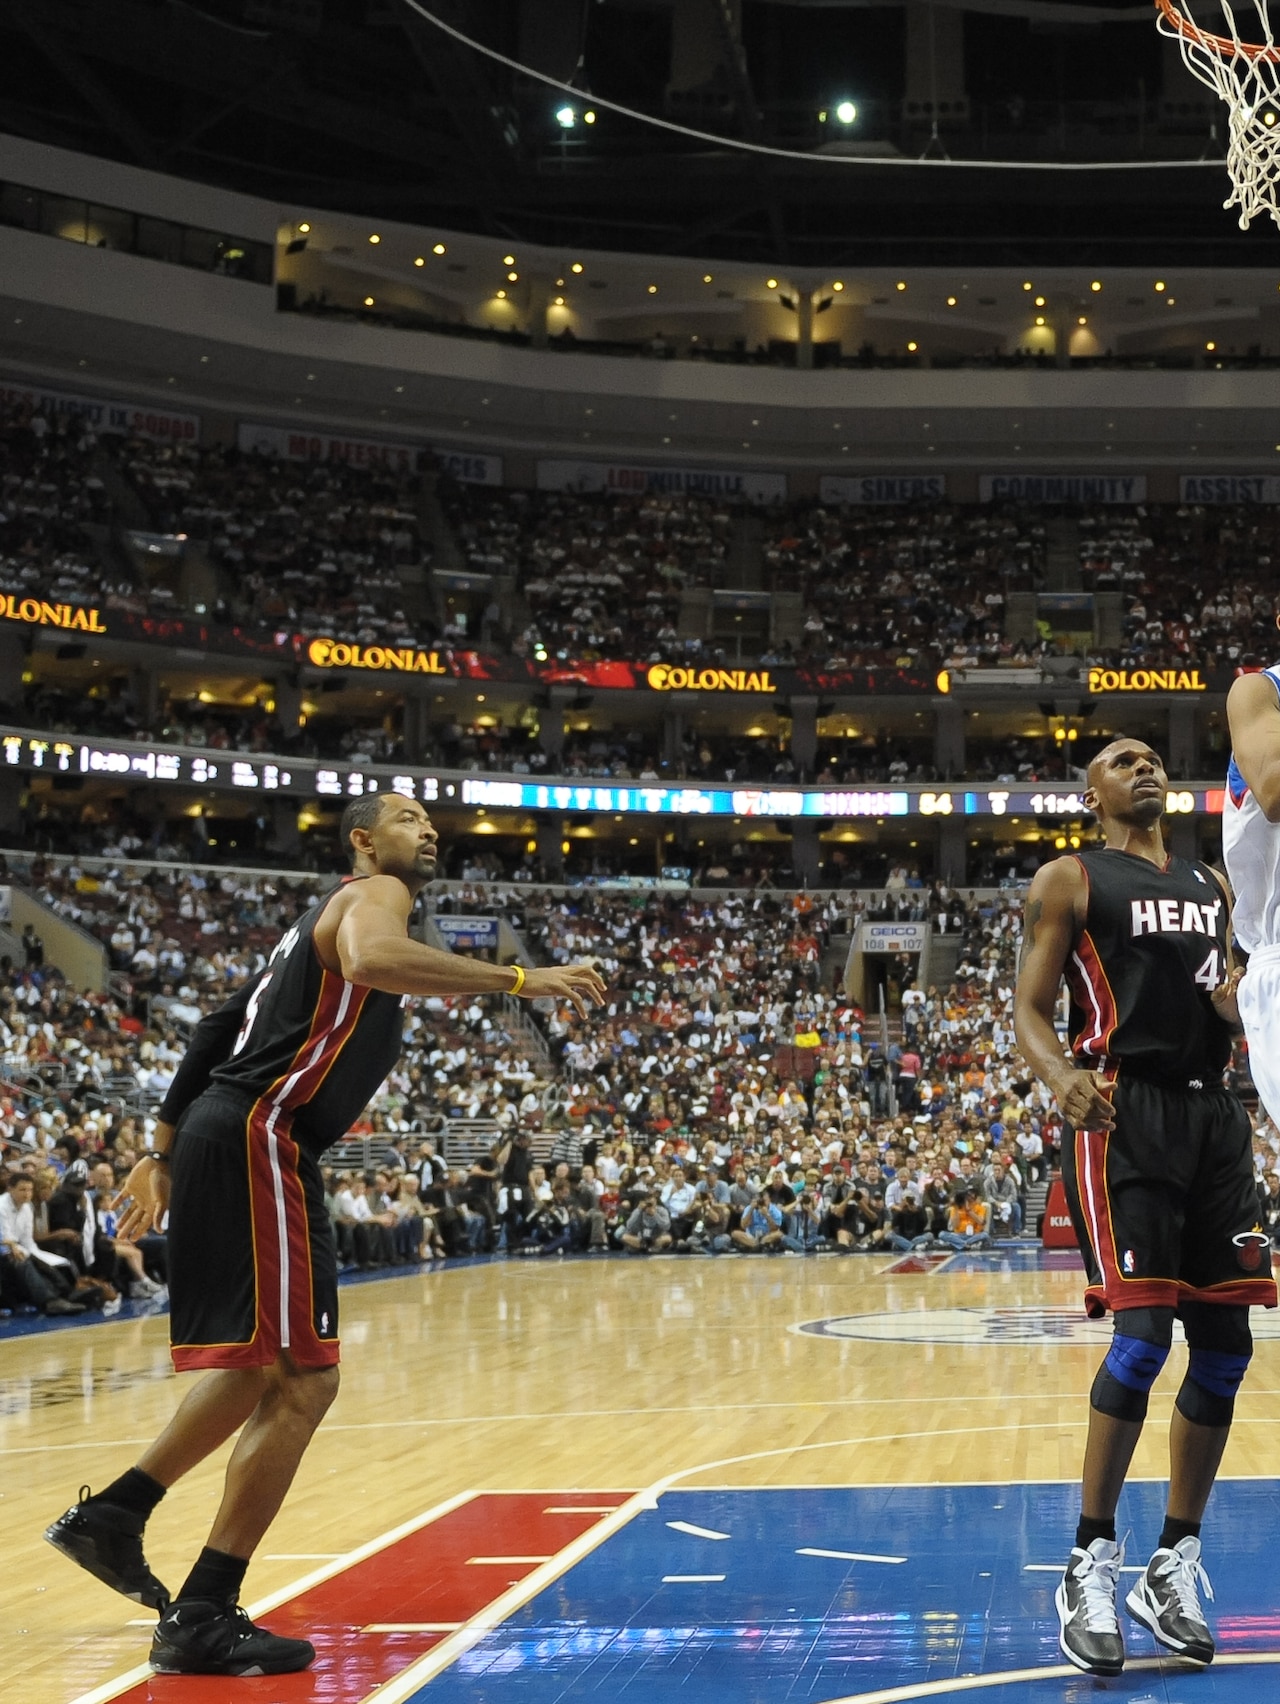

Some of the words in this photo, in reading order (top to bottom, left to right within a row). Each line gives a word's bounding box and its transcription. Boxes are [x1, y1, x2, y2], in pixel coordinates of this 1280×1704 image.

[861, 478, 940, 501] SIXERS
[991, 478, 1134, 501] COMMUNITY
[1185, 478, 1265, 501] ASSIST
[309, 639, 446, 674] COLONIAL
[648, 664, 776, 692] COLONIAL
[1089, 667, 1206, 692] COLONIAL
[919, 792, 952, 815] 54
[1030, 794, 1092, 815] 11:4
[440, 920, 492, 932] GEICO
[1131, 898, 1222, 938] HEAT
[871, 928, 916, 936] GEICO
[865, 940, 885, 949] 108
[1050, 1216, 1072, 1227] KIA
